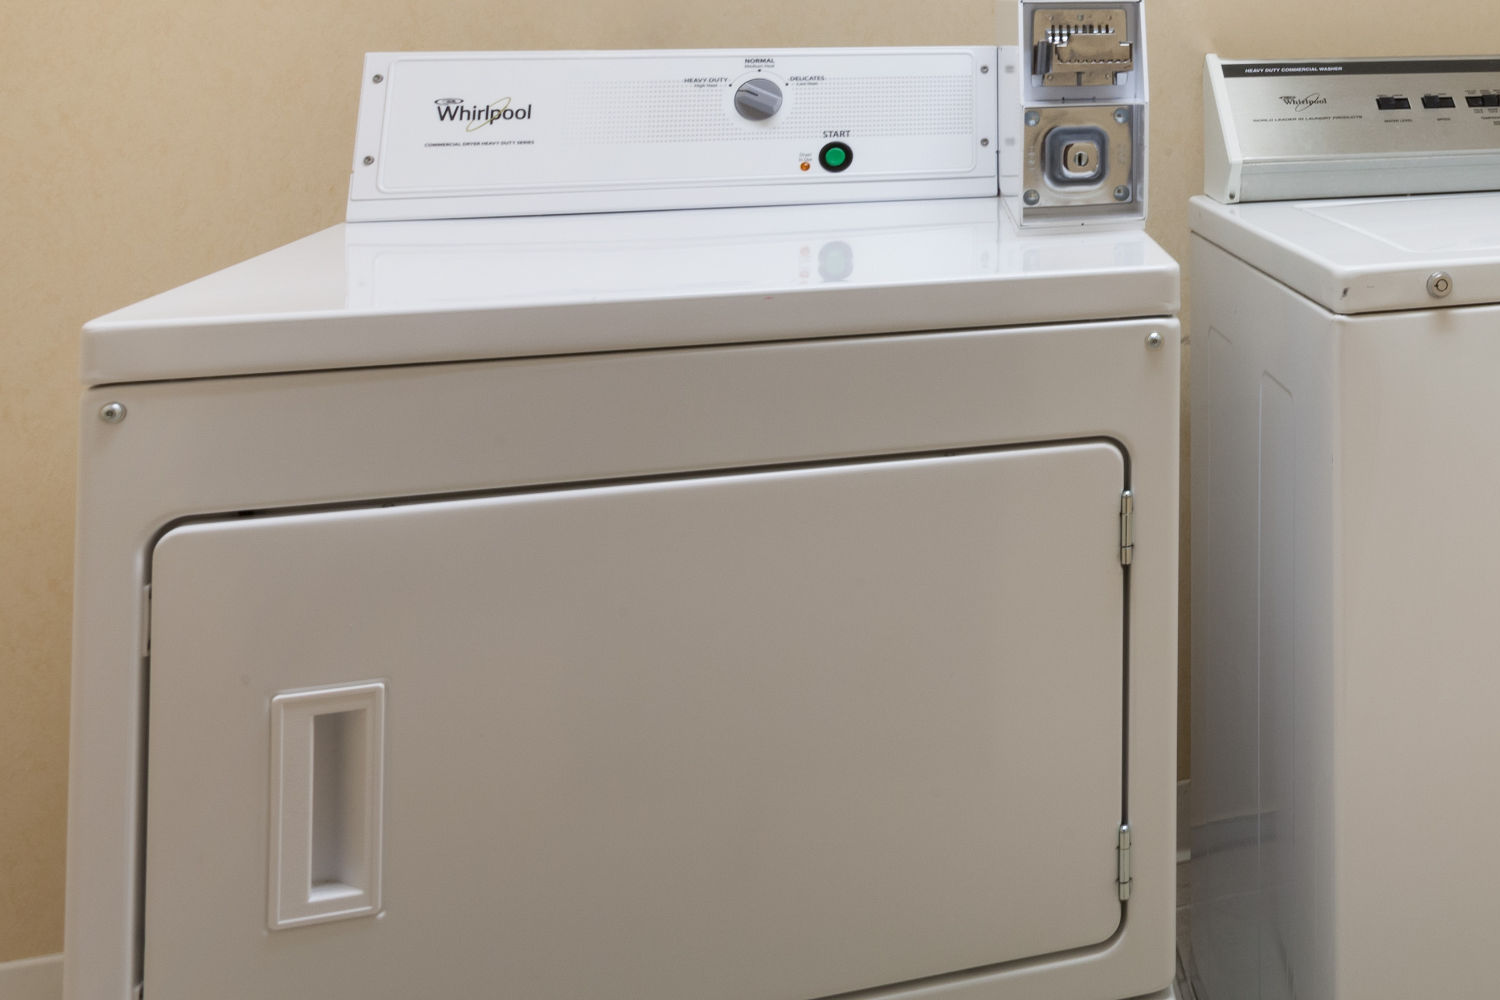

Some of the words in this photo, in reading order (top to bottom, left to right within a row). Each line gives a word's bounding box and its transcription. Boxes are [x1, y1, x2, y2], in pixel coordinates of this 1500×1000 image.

[1283, 97, 1327, 106] Whirlpool
[437, 104, 532, 125] Whirlpool
[822, 130, 851, 138] START
